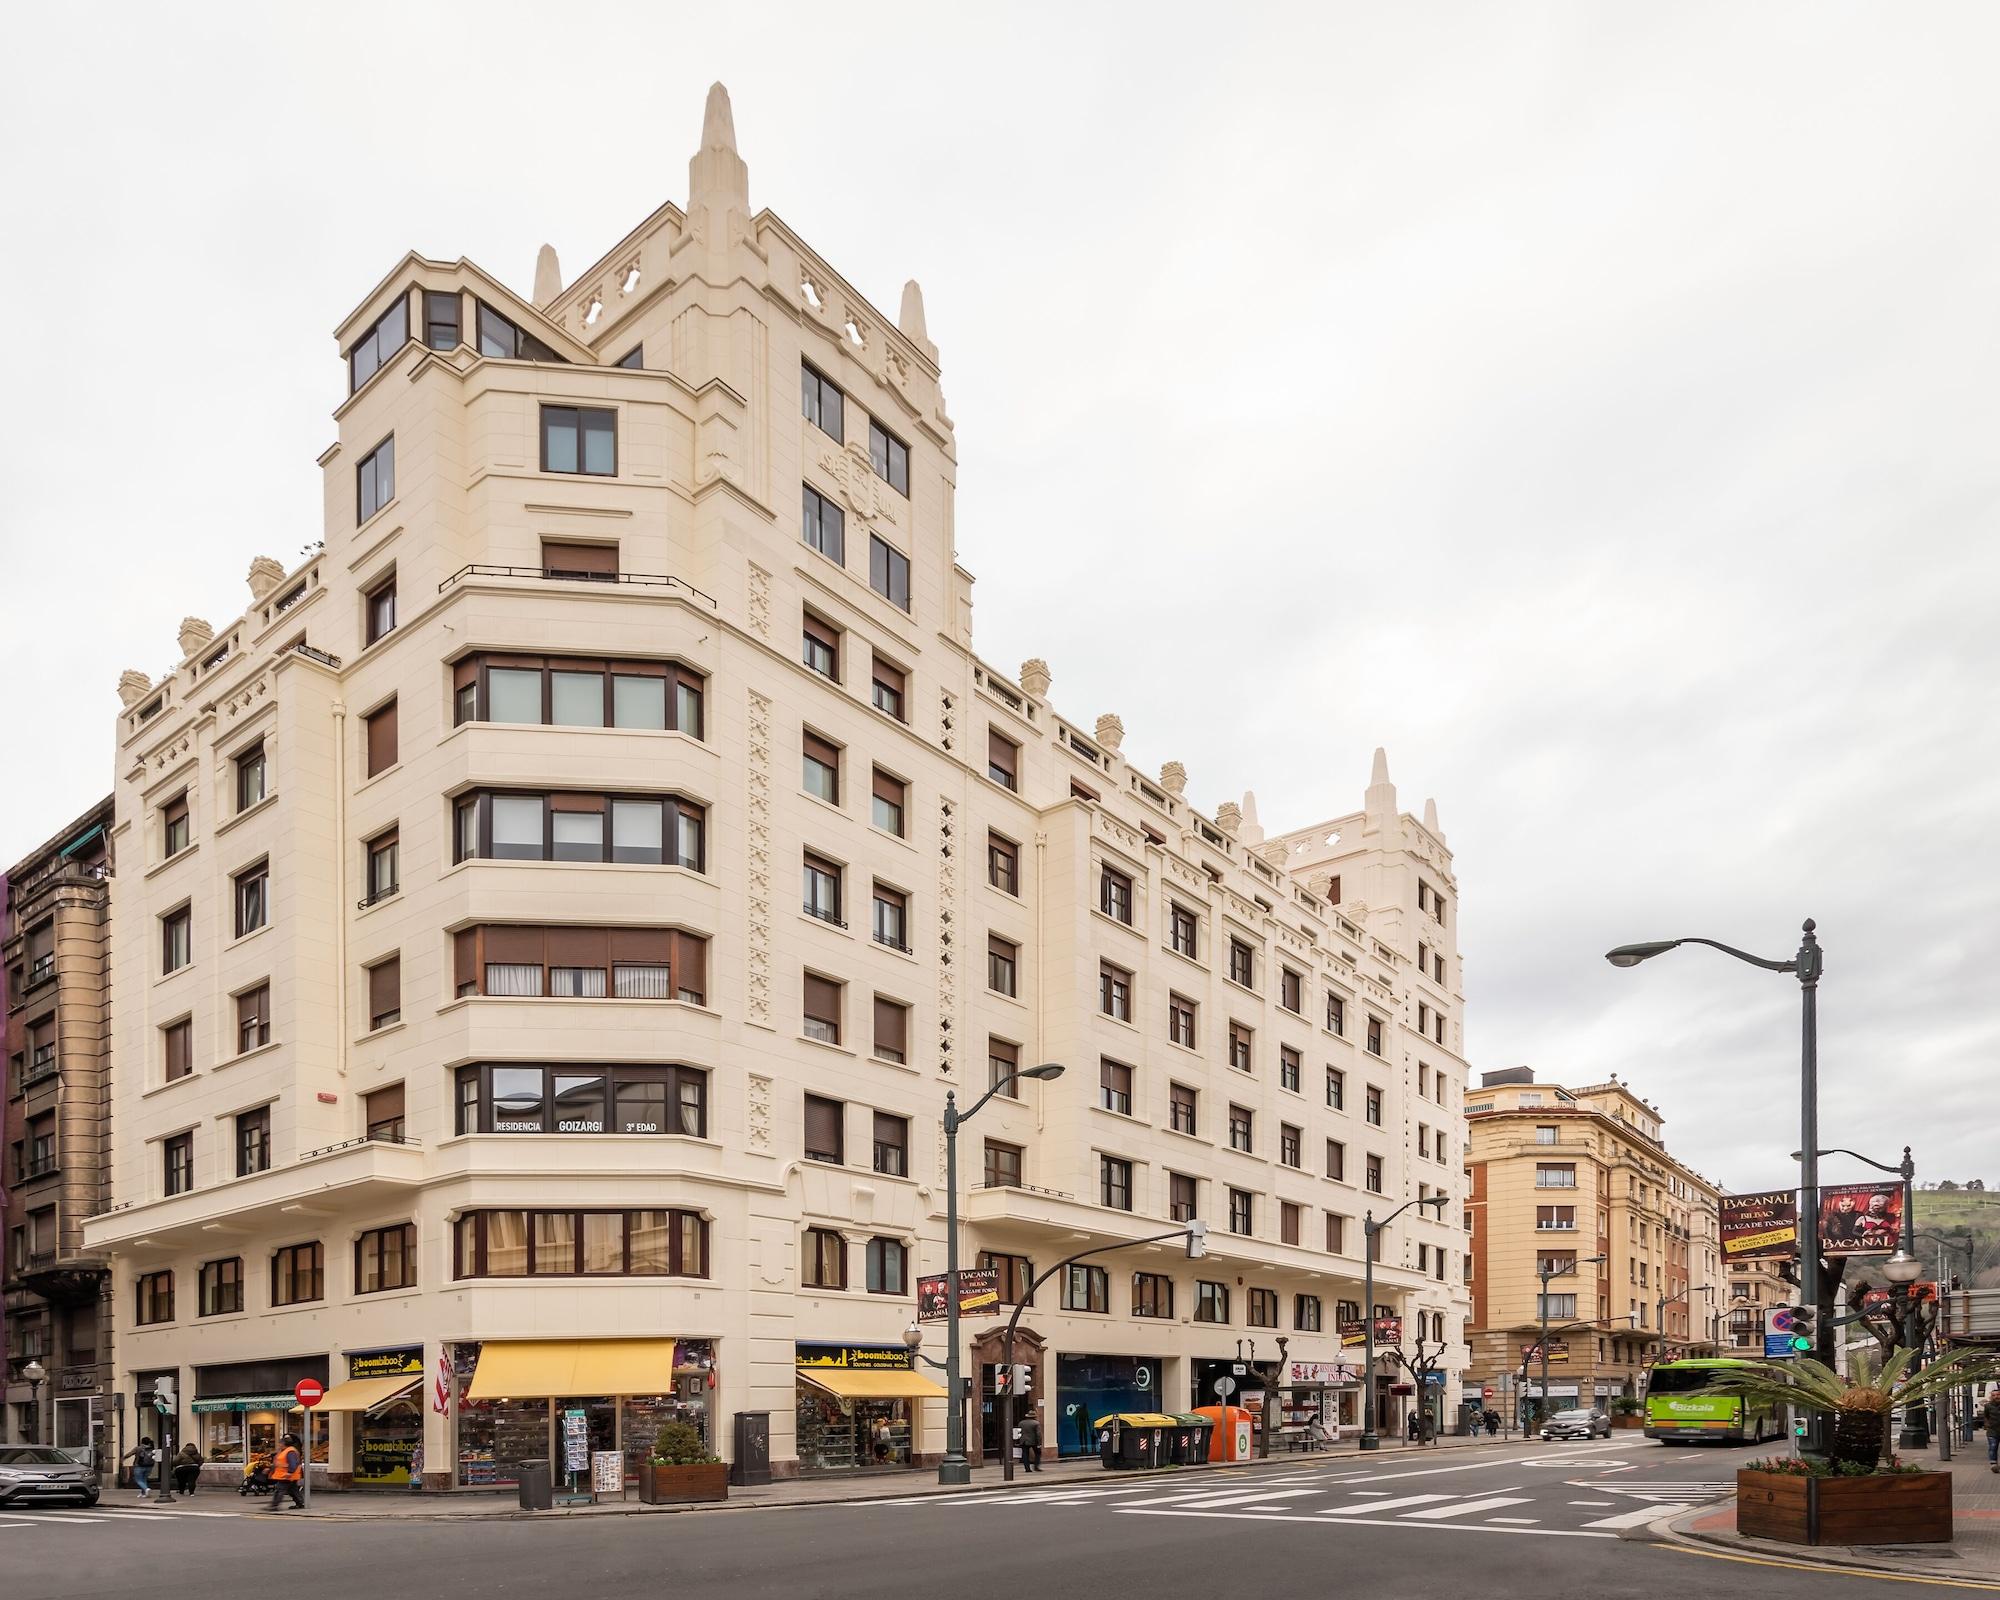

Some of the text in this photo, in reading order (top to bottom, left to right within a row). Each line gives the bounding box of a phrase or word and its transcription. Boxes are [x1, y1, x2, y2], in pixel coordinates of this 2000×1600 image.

[496, 1122, 541, 1132] RESIDENCIA
[558, 1120, 603, 1132] GOIZARGI
[636, 1123, 657, 1132] EDAD
[1723, 1193, 1795, 1210] BACANAL
[1740, 1210, 1774, 1220] BILBAO
[1723, 1218, 1794, 1231] PLAZA DE TOROS
[1739, 1239, 1761, 1249] HASTA
[1822, 1236, 1895, 1249] BACANAL
[960, 1269, 999, 1280] BACANAL
[857, 1349, 904, 1361] boombilbao
[197, 1403, 228, 1413] FRUTERIA
[270, 1400, 299, 1409] RODRIG
[1675, 1403, 1715, 1412] Bizkaia
